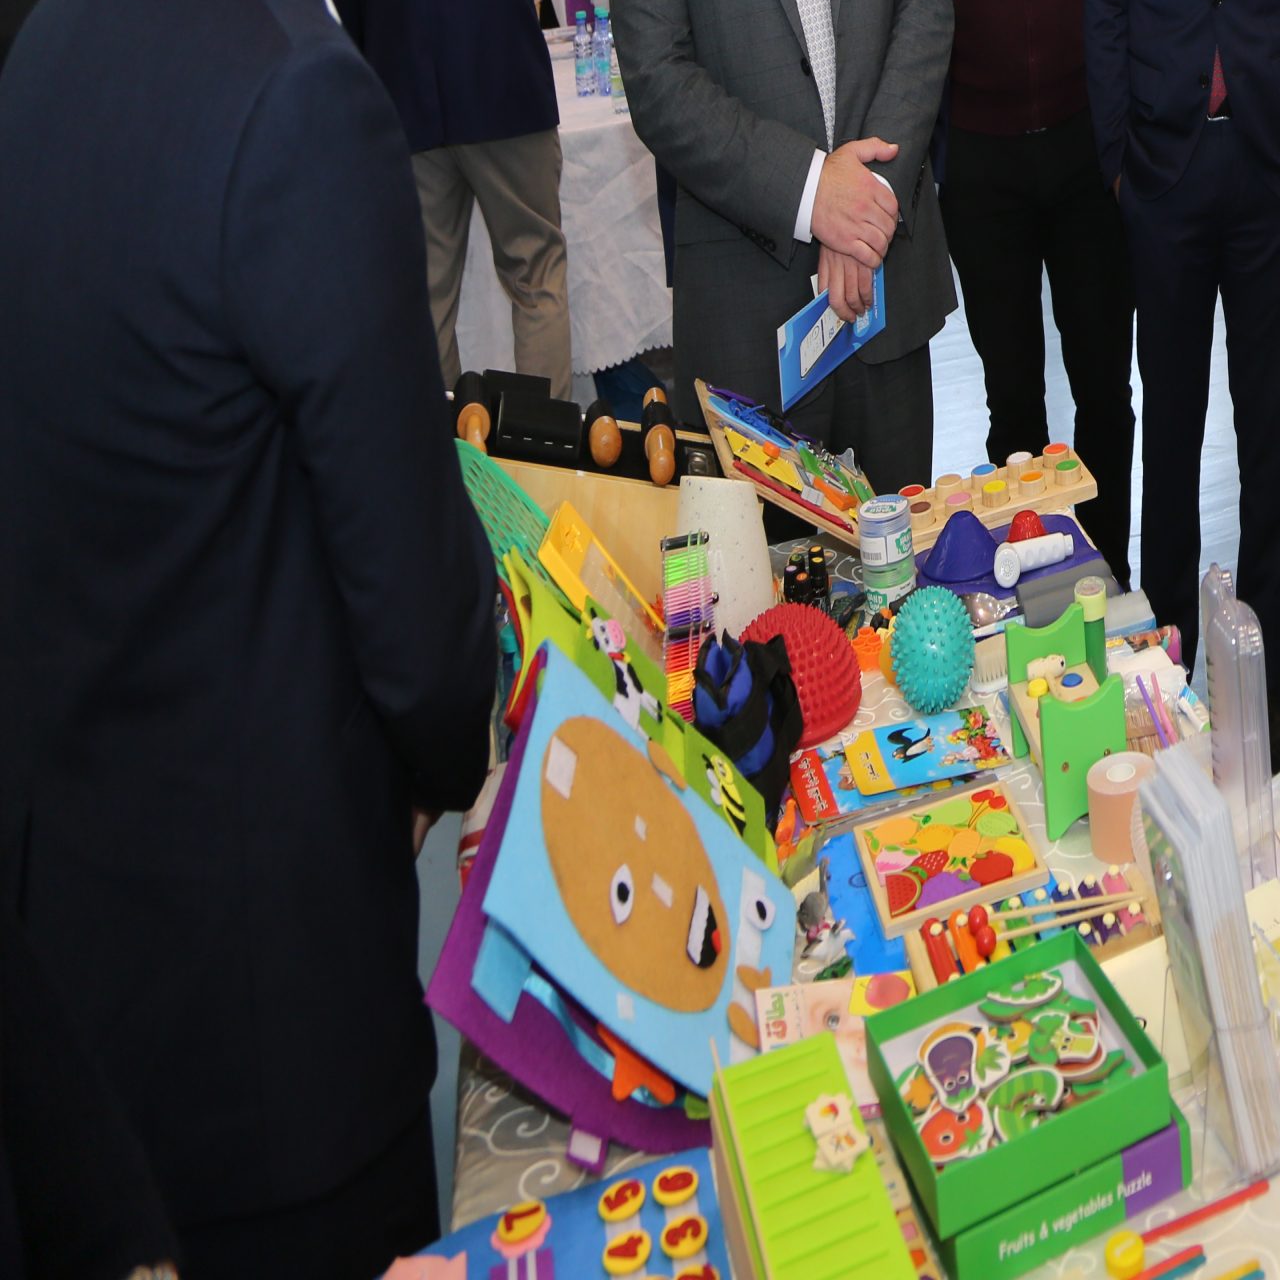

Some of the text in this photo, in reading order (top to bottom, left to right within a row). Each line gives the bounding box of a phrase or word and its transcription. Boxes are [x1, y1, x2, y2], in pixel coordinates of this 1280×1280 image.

[999, 1171, 1152, 1261] Fruits & vegetables Puzzle
